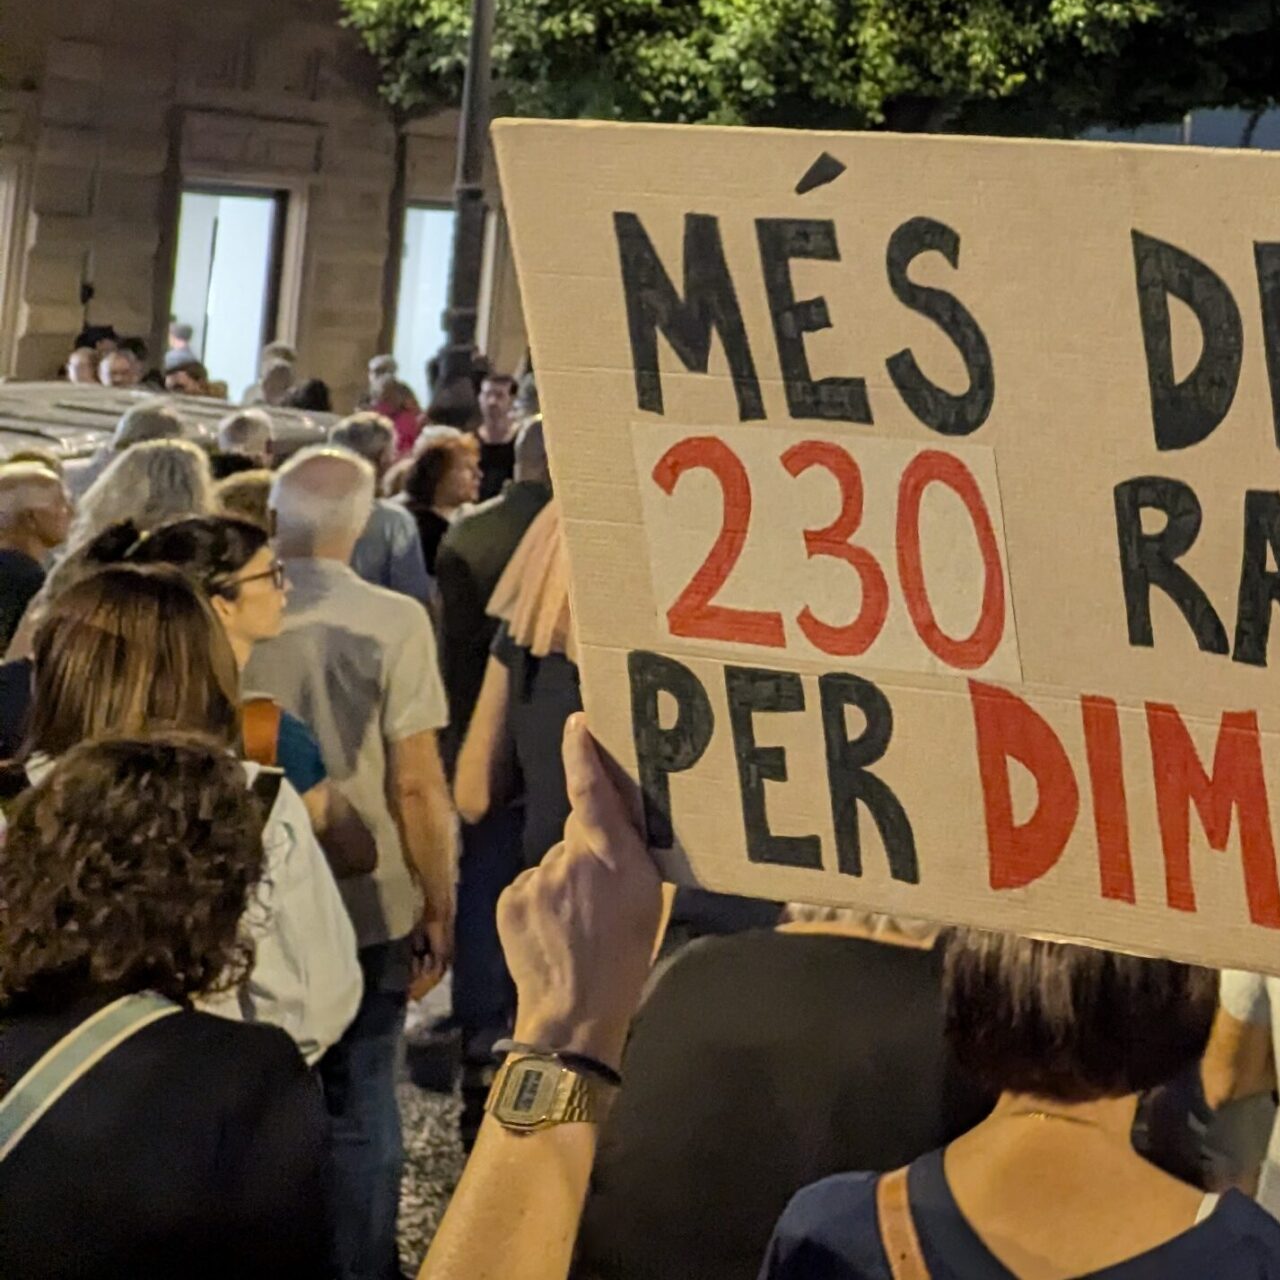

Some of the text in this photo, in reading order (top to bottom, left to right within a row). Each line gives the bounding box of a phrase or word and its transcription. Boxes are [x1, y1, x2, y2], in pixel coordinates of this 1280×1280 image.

[613, 151, 995, 436] MÉS
[651, 435, 1006, 670] 230
[627, 650, 920, 884] PER
